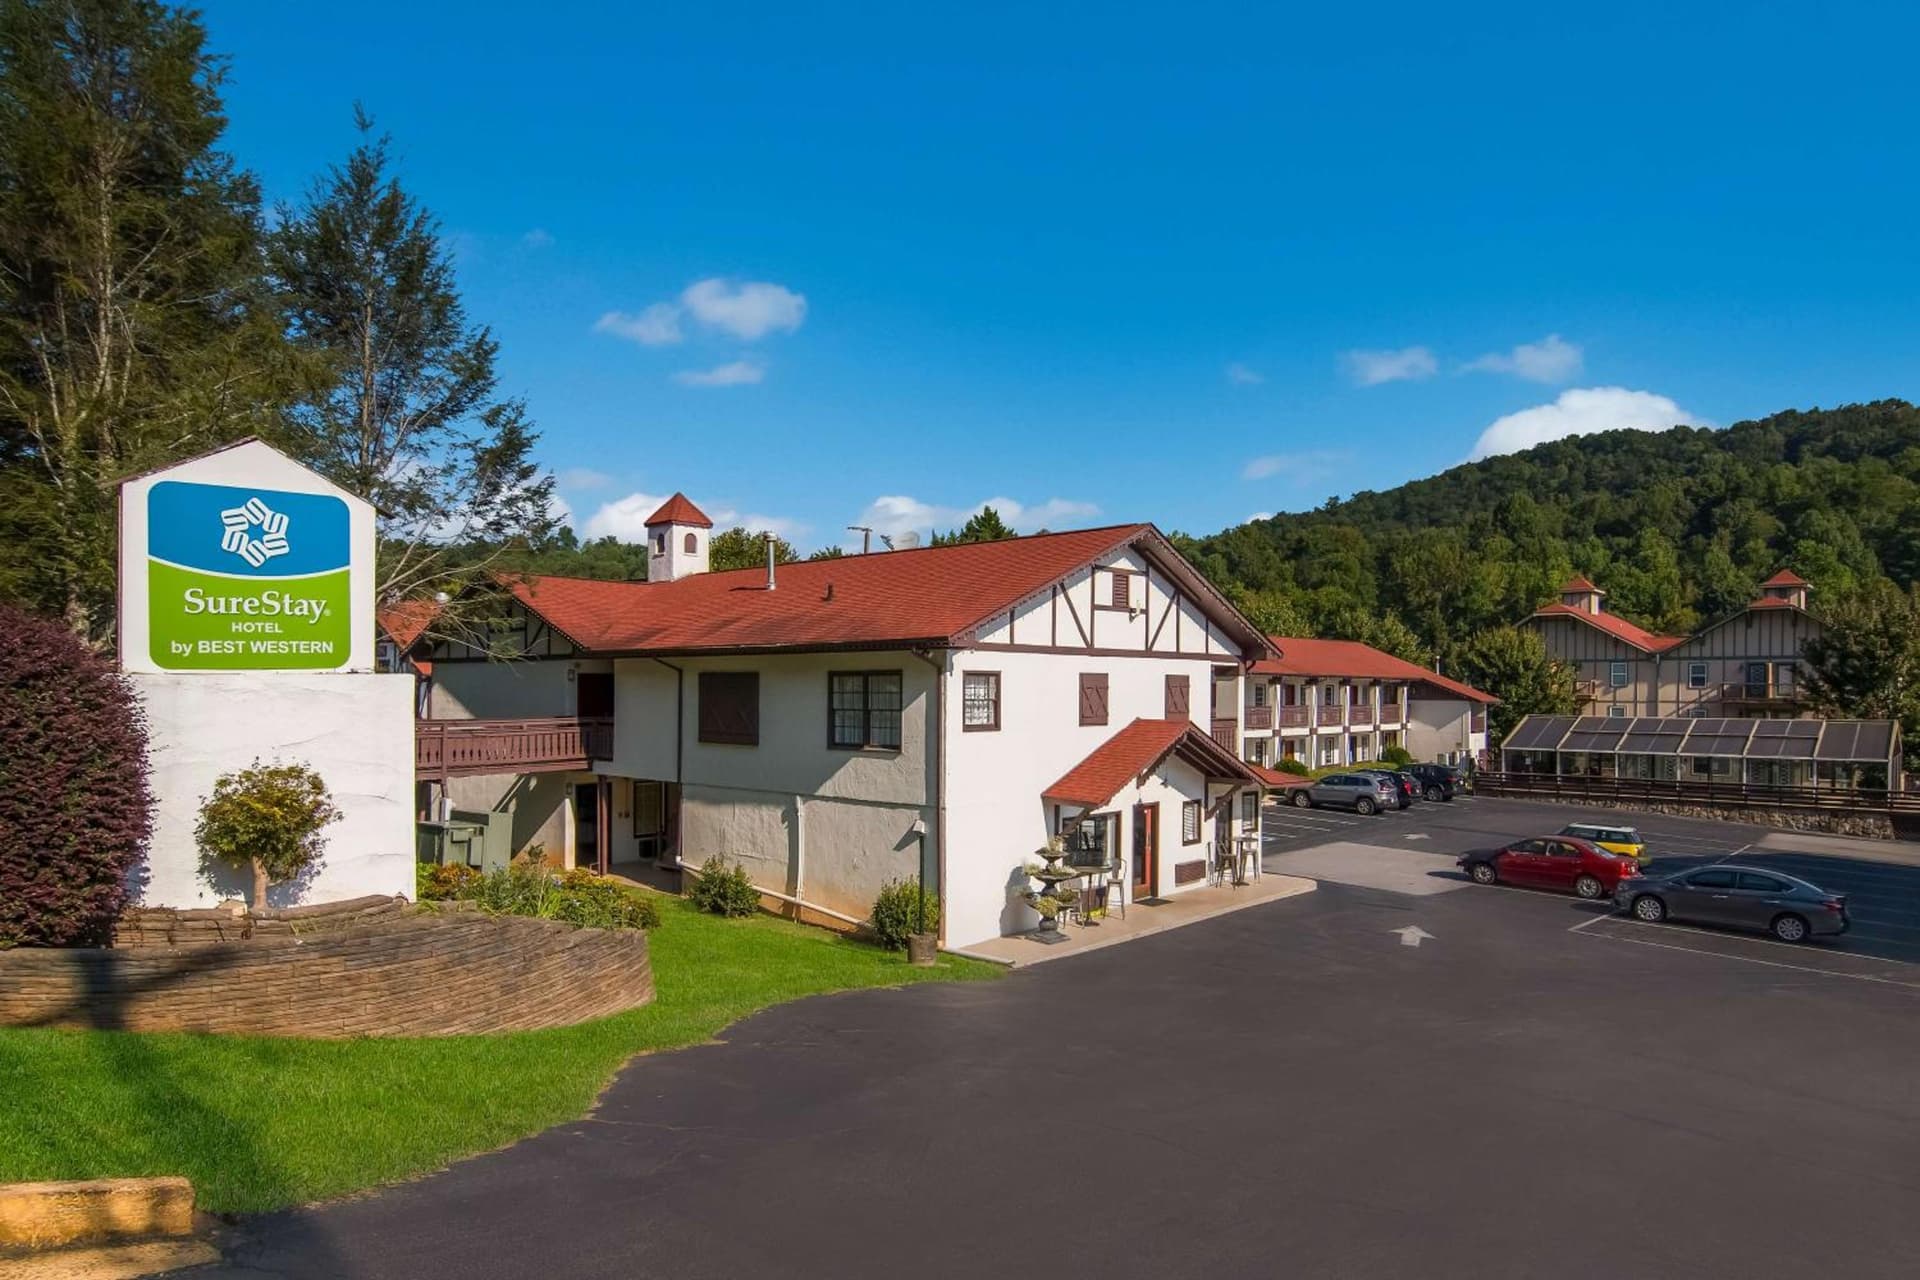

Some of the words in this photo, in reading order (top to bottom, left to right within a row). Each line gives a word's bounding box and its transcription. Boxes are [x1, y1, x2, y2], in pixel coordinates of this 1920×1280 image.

[231, 622, 283, 633] HOTEL
[171, 641, 193, 656] by
[198, 640, 244, 654] BEST
[250, 640, 334, 654] WESTERN
